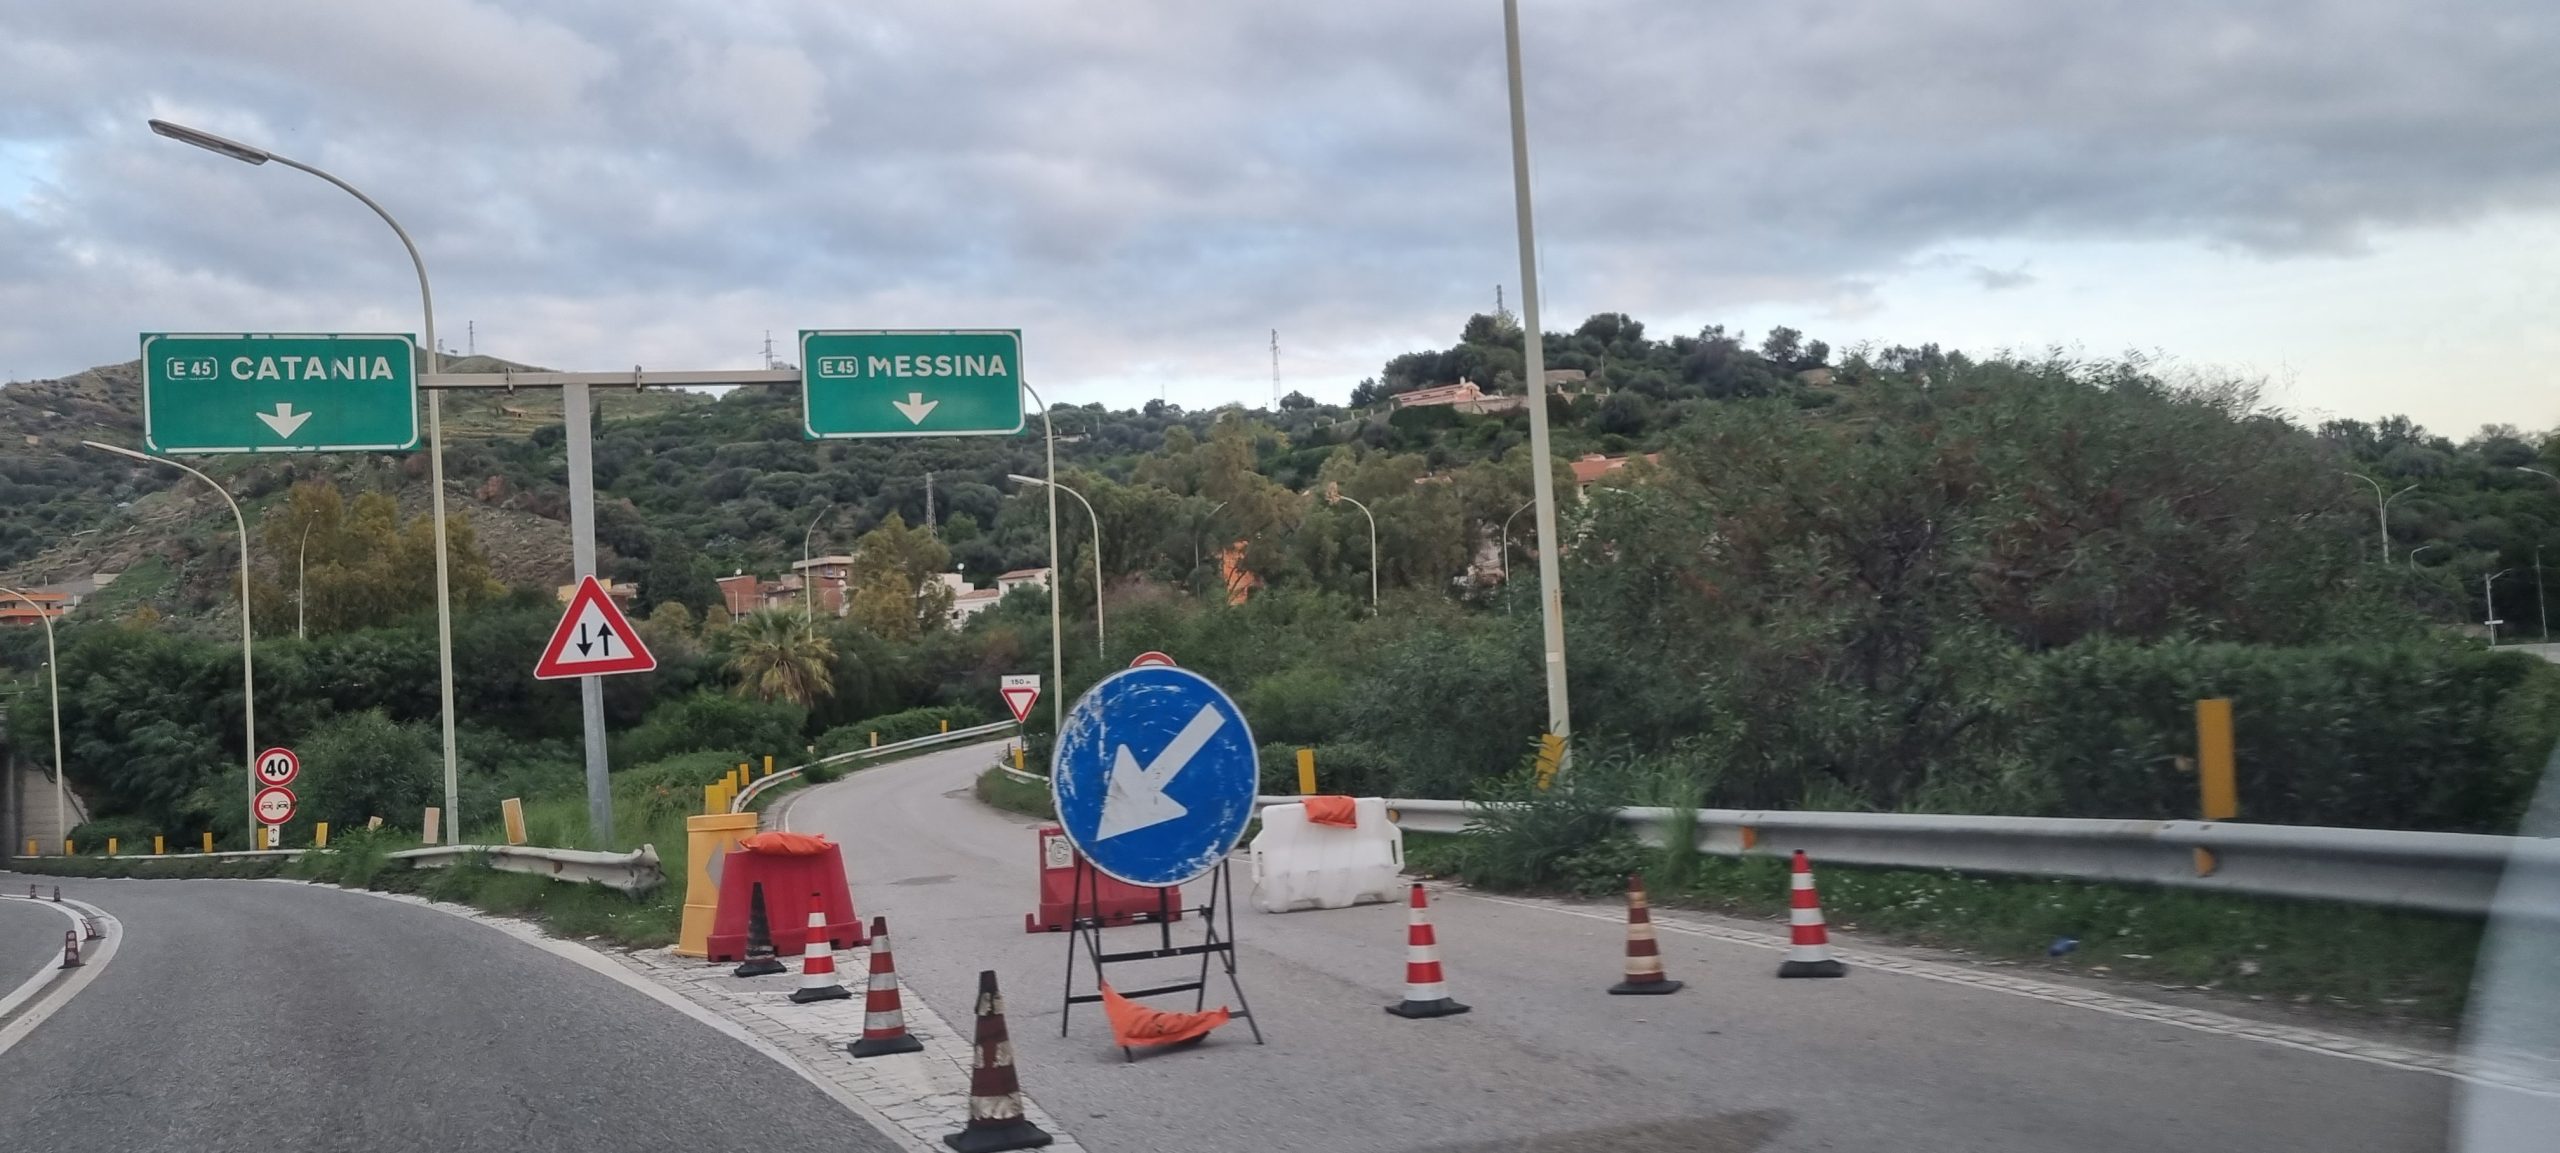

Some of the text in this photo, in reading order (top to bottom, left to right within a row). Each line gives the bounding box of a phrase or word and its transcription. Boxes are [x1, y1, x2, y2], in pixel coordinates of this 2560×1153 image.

[173, 355, 394, 381] E 45 CATANIA
[822, 354, 1008, 378] E 45 MESSINA
[264, 758, 289, 776] 40
